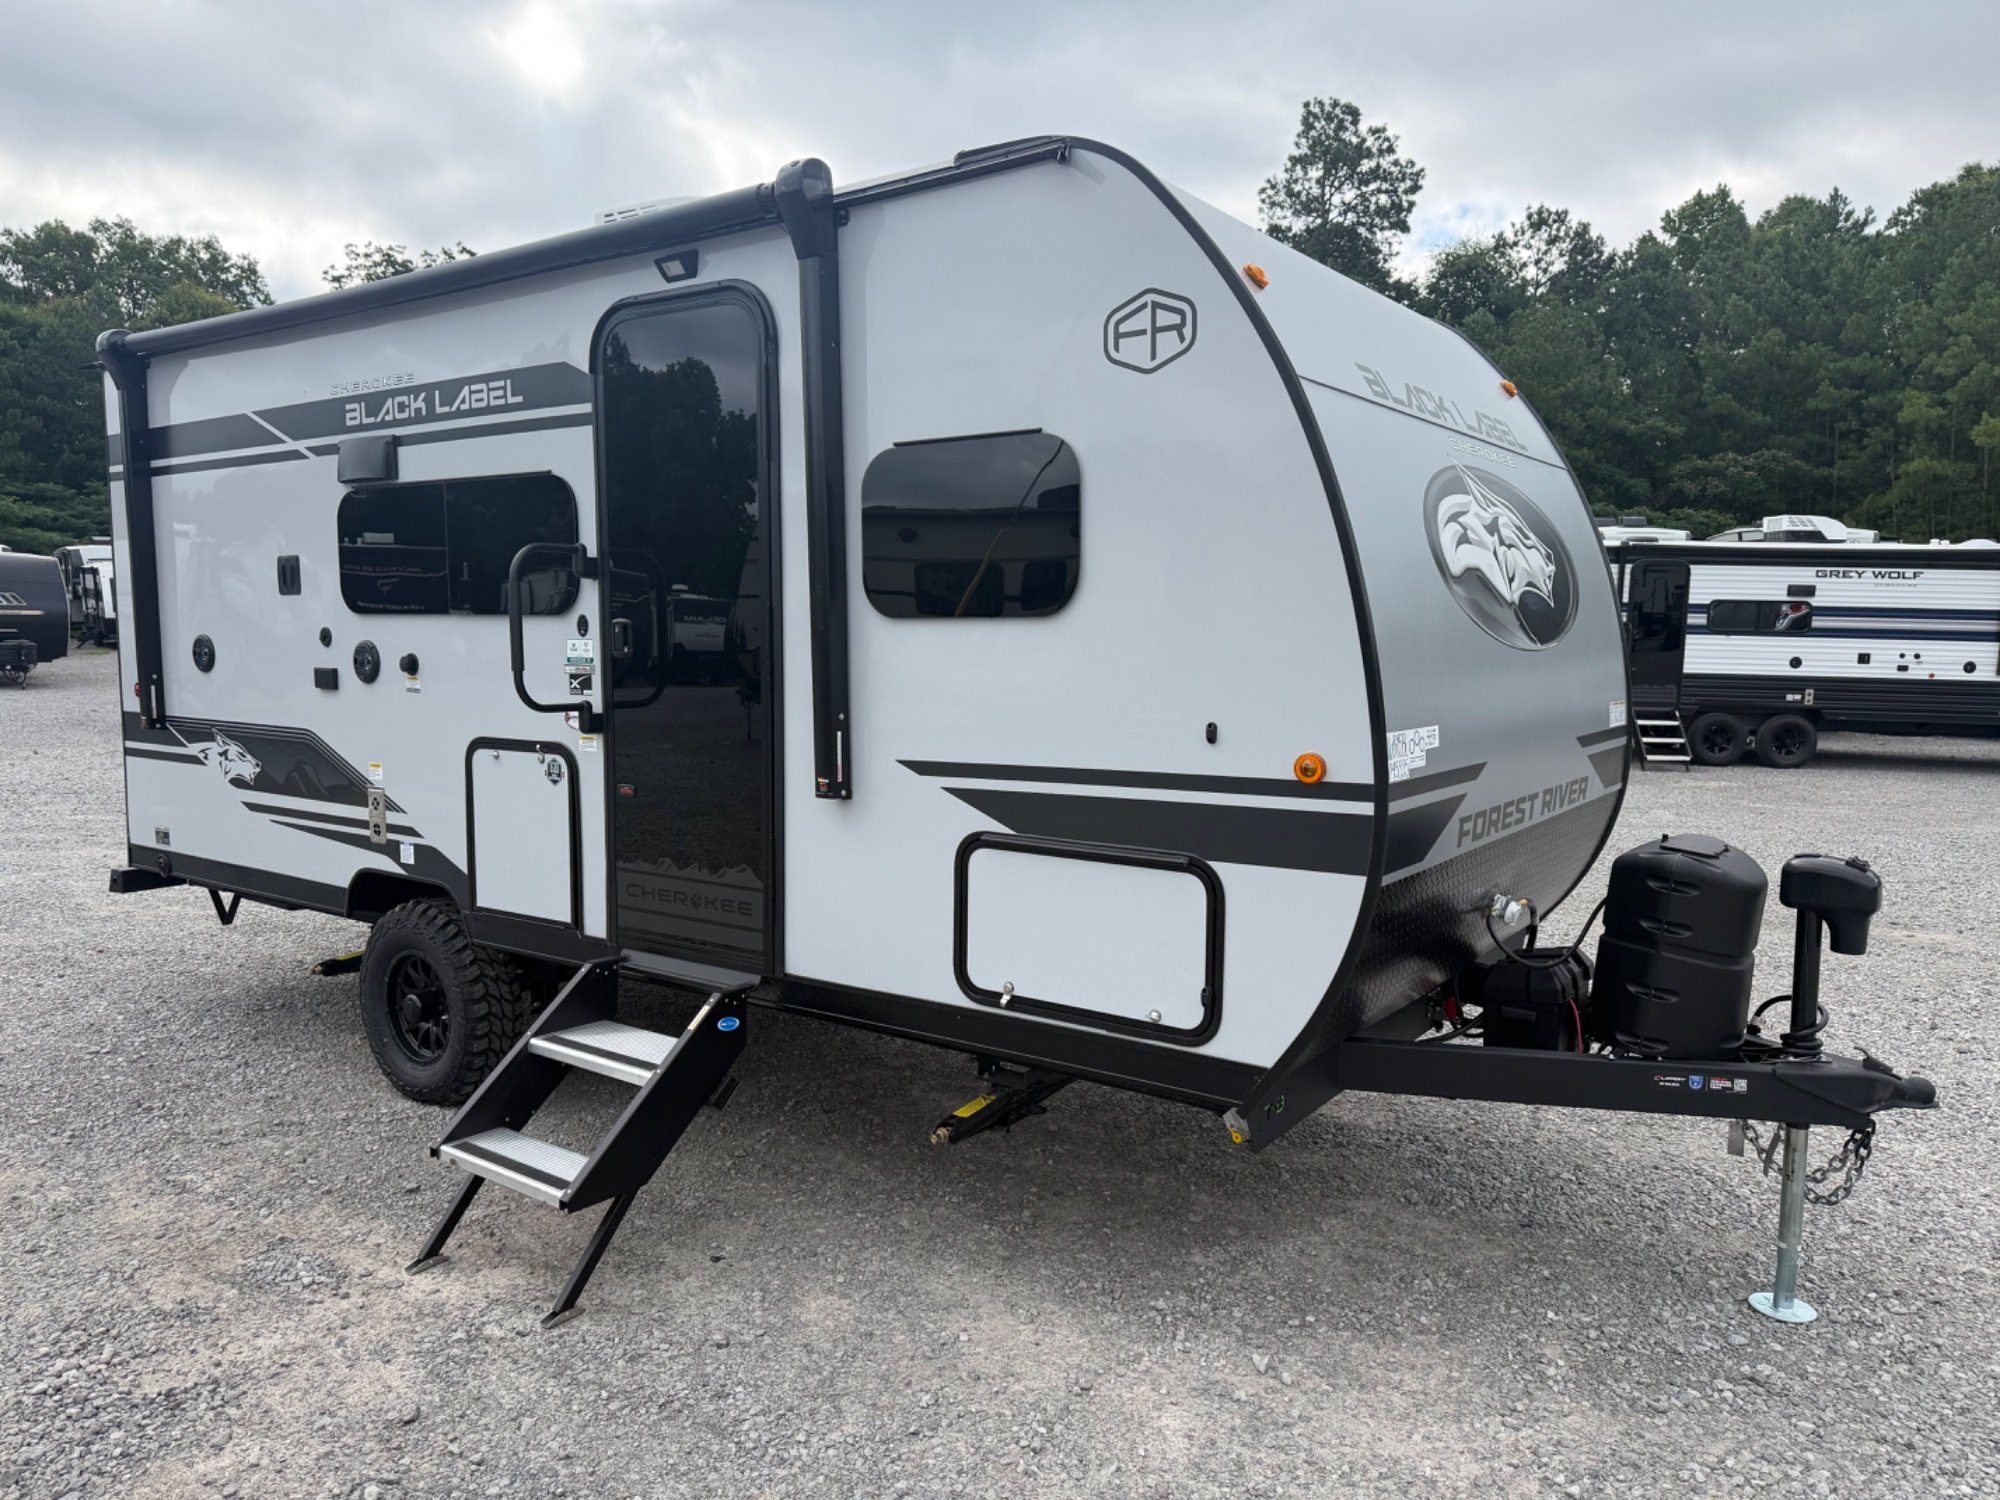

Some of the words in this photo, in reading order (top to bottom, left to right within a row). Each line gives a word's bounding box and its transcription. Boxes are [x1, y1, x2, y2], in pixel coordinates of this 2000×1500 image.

[329, 373, 415, 396] CHEROKEE
[345, 391, 427, 426] BLACK
[435, 379, 524, 414] LABEL
[1354, 362, 1459, 426] BLACK
[1451, 400, 1529, 451] LABEL
[1815, 569, 1867, 579] GREY
[1871, 570, 1924, 580] WOLF
[1457, 791, 1540, 848] FOREST
[1540, 775, 1589, 816] RIVER
